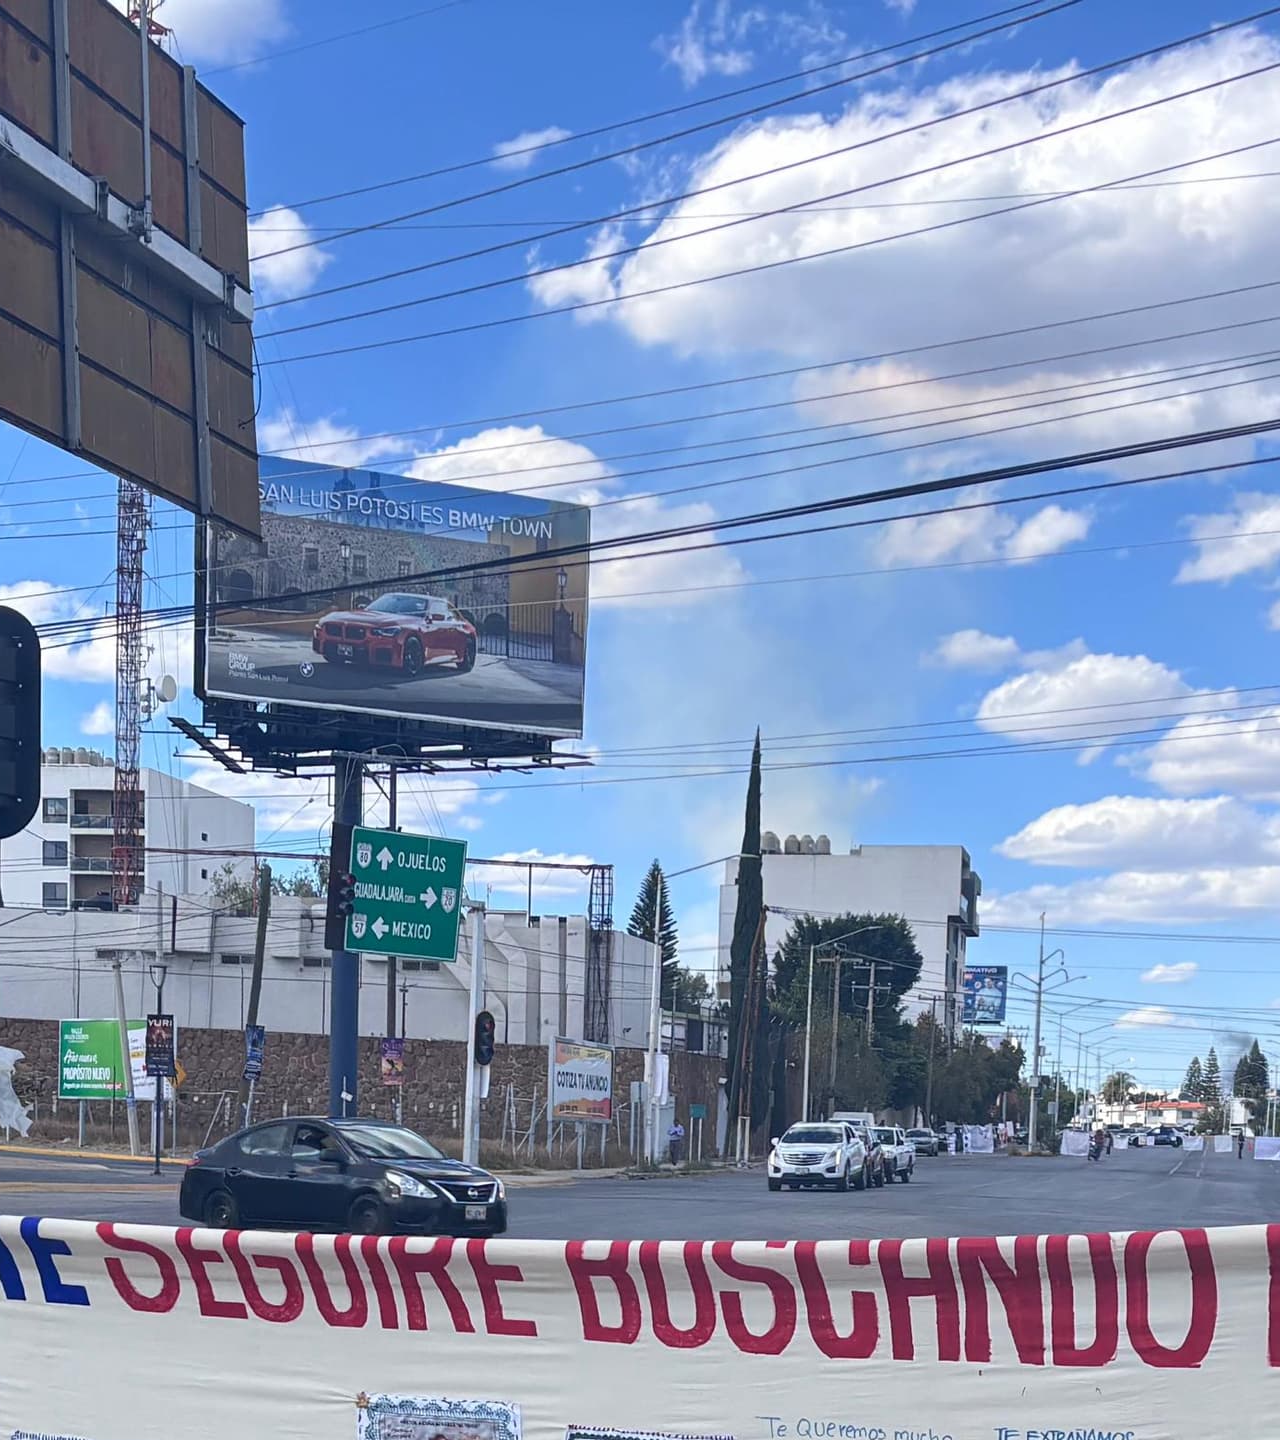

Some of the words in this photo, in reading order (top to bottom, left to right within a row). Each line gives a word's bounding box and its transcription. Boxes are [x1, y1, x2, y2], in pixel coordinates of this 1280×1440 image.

[259, 482, 293, 504] SAN
[299, 488, 341, 510] LUIS
[347, 492, 417, 521] POTOSÍ
[421, 505, 443, 524] ES
[449, 510, 494, 531] BMW
[499, 516, 553, 539] TOWN
[398, 851, 446, 872] OJUELOS
[354, 883, 404, 902] GUADALAJARA
[354, 923, 363, 933] 57
[392, 921, 431, 940] MEXICO
[557, 1071, 577, 1087] COTIZA
[577, 1073, 585, 1088] TU
[585, 1075, 608, 1092] ANUNCIO
[564, 1229, 1218, 1370] BUSCANDO
[755, 1417, 787, 1437] Te
[797, 1421, 887, 1440] Queremos
